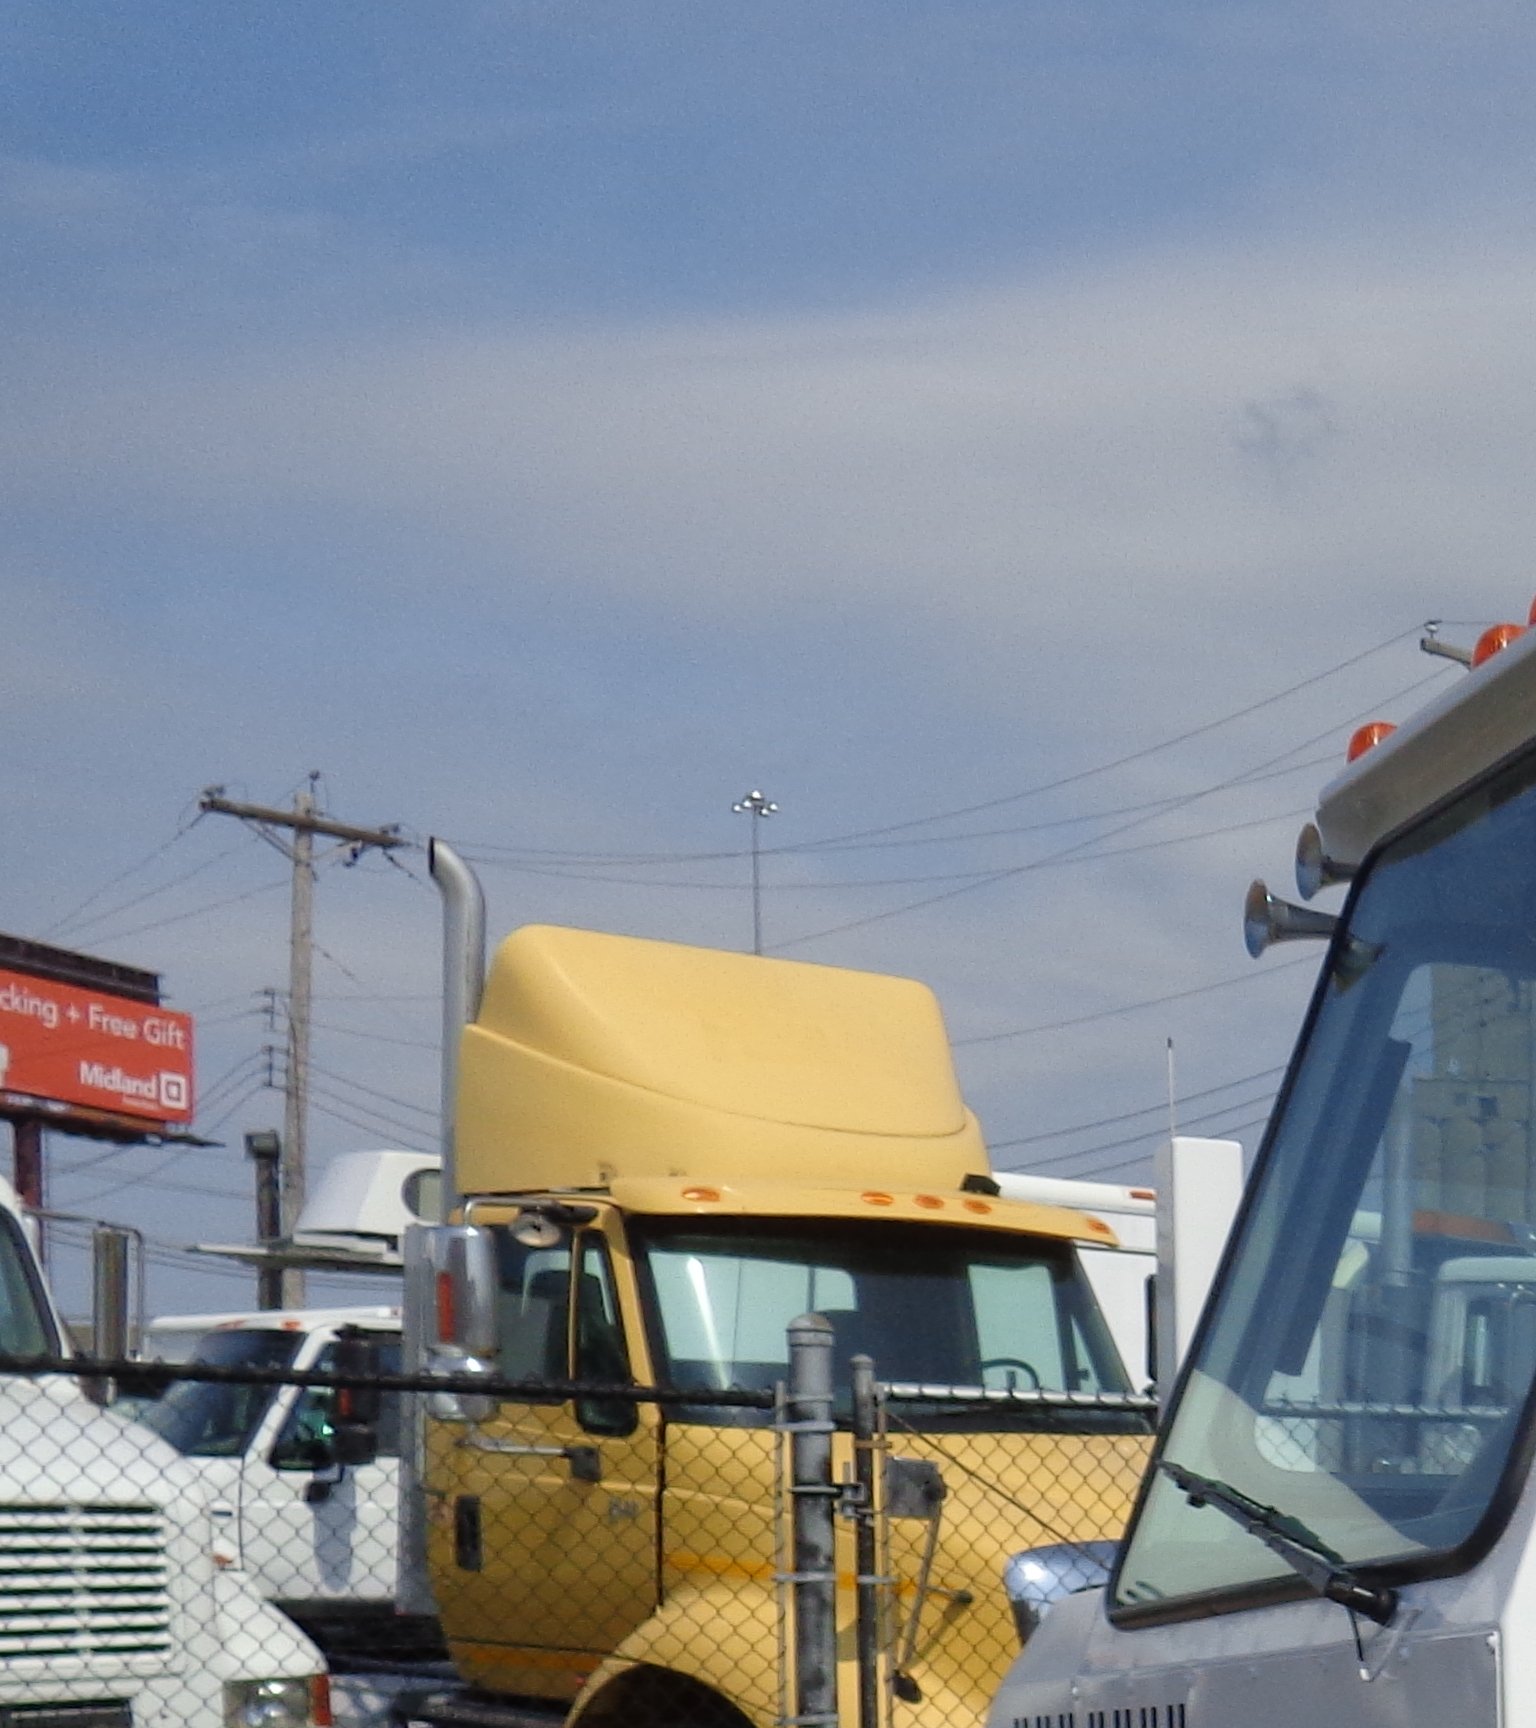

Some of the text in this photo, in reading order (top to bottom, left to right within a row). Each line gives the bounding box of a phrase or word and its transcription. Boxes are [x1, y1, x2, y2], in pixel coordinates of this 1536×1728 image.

[88, 1003, 137, 1039] Free
[143, 1017, 185, 1050] Gift
[80, 1061, 157, 1099] Midland
